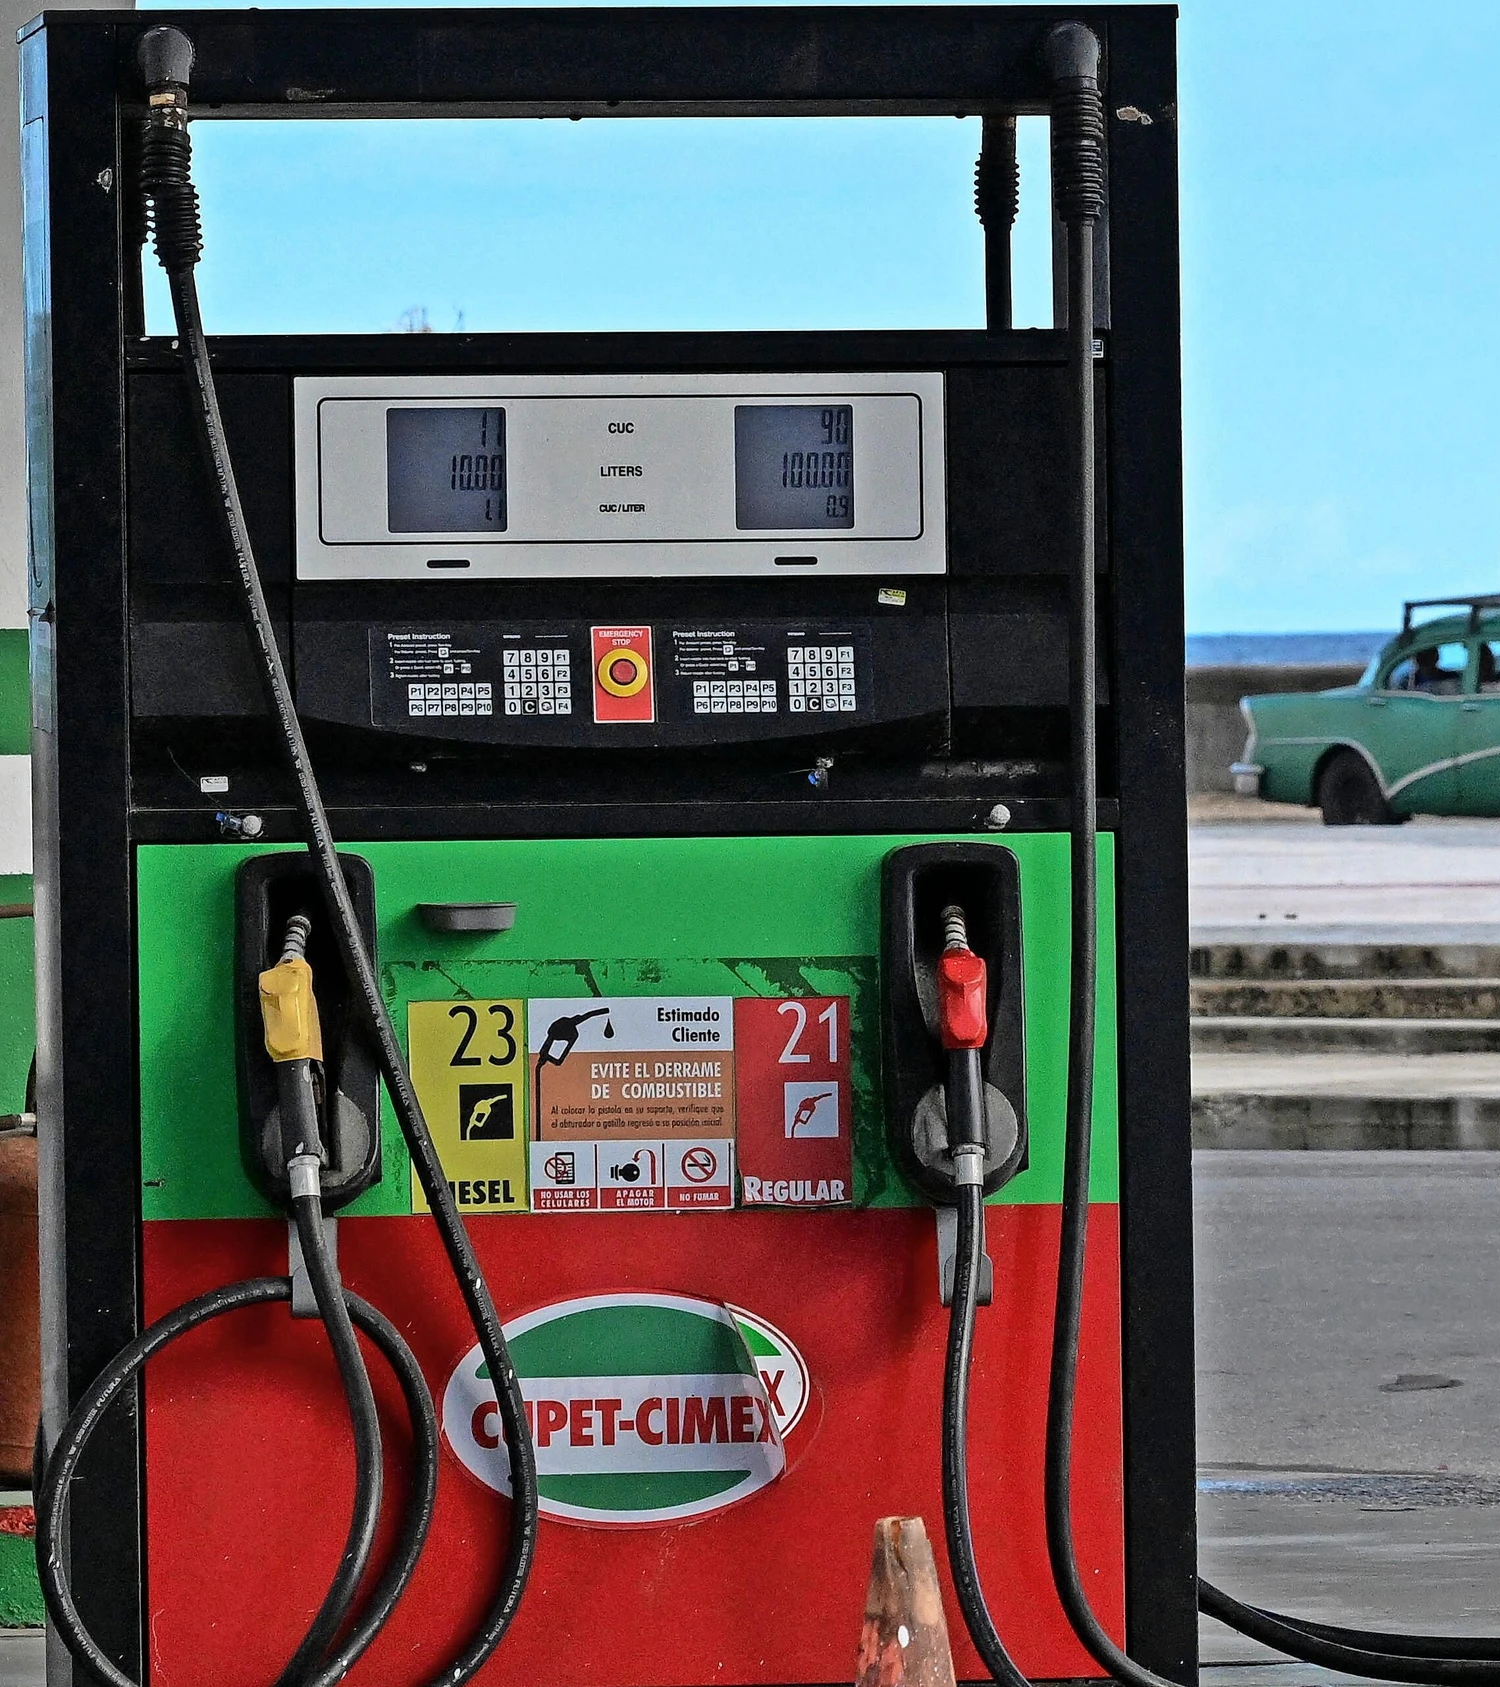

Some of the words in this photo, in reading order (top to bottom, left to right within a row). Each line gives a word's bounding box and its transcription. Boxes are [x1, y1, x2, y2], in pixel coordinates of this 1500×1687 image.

[608, 422, 634, 434] CUC
[821, 408, 850, 445] 90
[600, 466, 643, 477] LITERS
[507, 653, 515, 663] 7
[524, 652, 531, 662] 8
[541, 652, 548, 662] 9
[792, 650, 799, 660] 7
[809, 650, 816, 660] 8
[825, 650, 832, 660] 9
[508, 669, 515, 679] 4
[525, 669, 532, 679] 5
[542, 669, 549, 679] 6
[793, 666, 800, 677] 4
[809, 666, 816, 677] 5
[826, 666, 833, 676] 6
[411, 688, 421, 696] P1
[428, 687, 439, 695] P2
[444, 687, 456, 695] P3
[461, 687, 472, 695] P4
[478, 687, 490, 695] P5
[509, 686, 514, 696] 1
[525, 685, 533, 695] 2
[542, 685, 550, 696] 3
[696, 685, 706, 693] P1
[746, 684, 758, 692] P4
[763, 684, 774, 692] P5
[794, 683, 799, 693] 1
[810, 683, 817, 693] 2
[826, 682, 834, 693] 3
[411, 704, 423, 712] P6
[428, 704, 440, 712] P7
[445, 704, 456, 712] P8
[462, 704, 473, 712] P9
[509, 702, 516, 712] 0
[525, 701, 535, 712] C
[713, 701, 725, 709] P7
[730, 701, 741, 709] P8
[794, 699, 801, 709] 0
[809, 698, 819, 710] C
[657, 1006, 720, 1022] Estimado
[449, 1005, 517, 1066] 23
[672, 1027, 720, 1042] Cliente
[777, 1001, 838, 1063] 21
[591, 1063, 629, 1079] EVITE
[635, 1063, 650, 1078] EL
[655, 1061, 721, 1078] DERRAME
[591, 1083, 610, 1099] DE
[621, 1082, 722, 1099] COMBUSTIBLE
[551, 1106, 558, 1114] Al
[561, 1106, 585, 1114] colocar
[598, 1105, 621, 1116] pistola
[677, 1104, 708, 1114] verifique
[551, 1119, 558, 1128] el
[560, 1118, 594, 1128] obturador
[603, 1118, 625, 1129] gatillo
[429, 1179, 515, 1205] IESEL
[541, 1191, 551, 1199] NO
[554, 1191, 573, 1199] USAR
[576, 1190, 590, 1199] LOS
[616, 1189, 654, 1198] APAGAR
[744, 1176, 845, 1202] REGULAR
[616, 1198, 625, 1206] EL
[627, 1198, 654, 1206] MOTOR
[679, 1193, 690, 1201] NO
[693, 1192, 719, 1201] FUMAR
[541, 1199, 590, 1208] CELULARES
[470, 1396, 778, 1449] CPET-CIMEX
